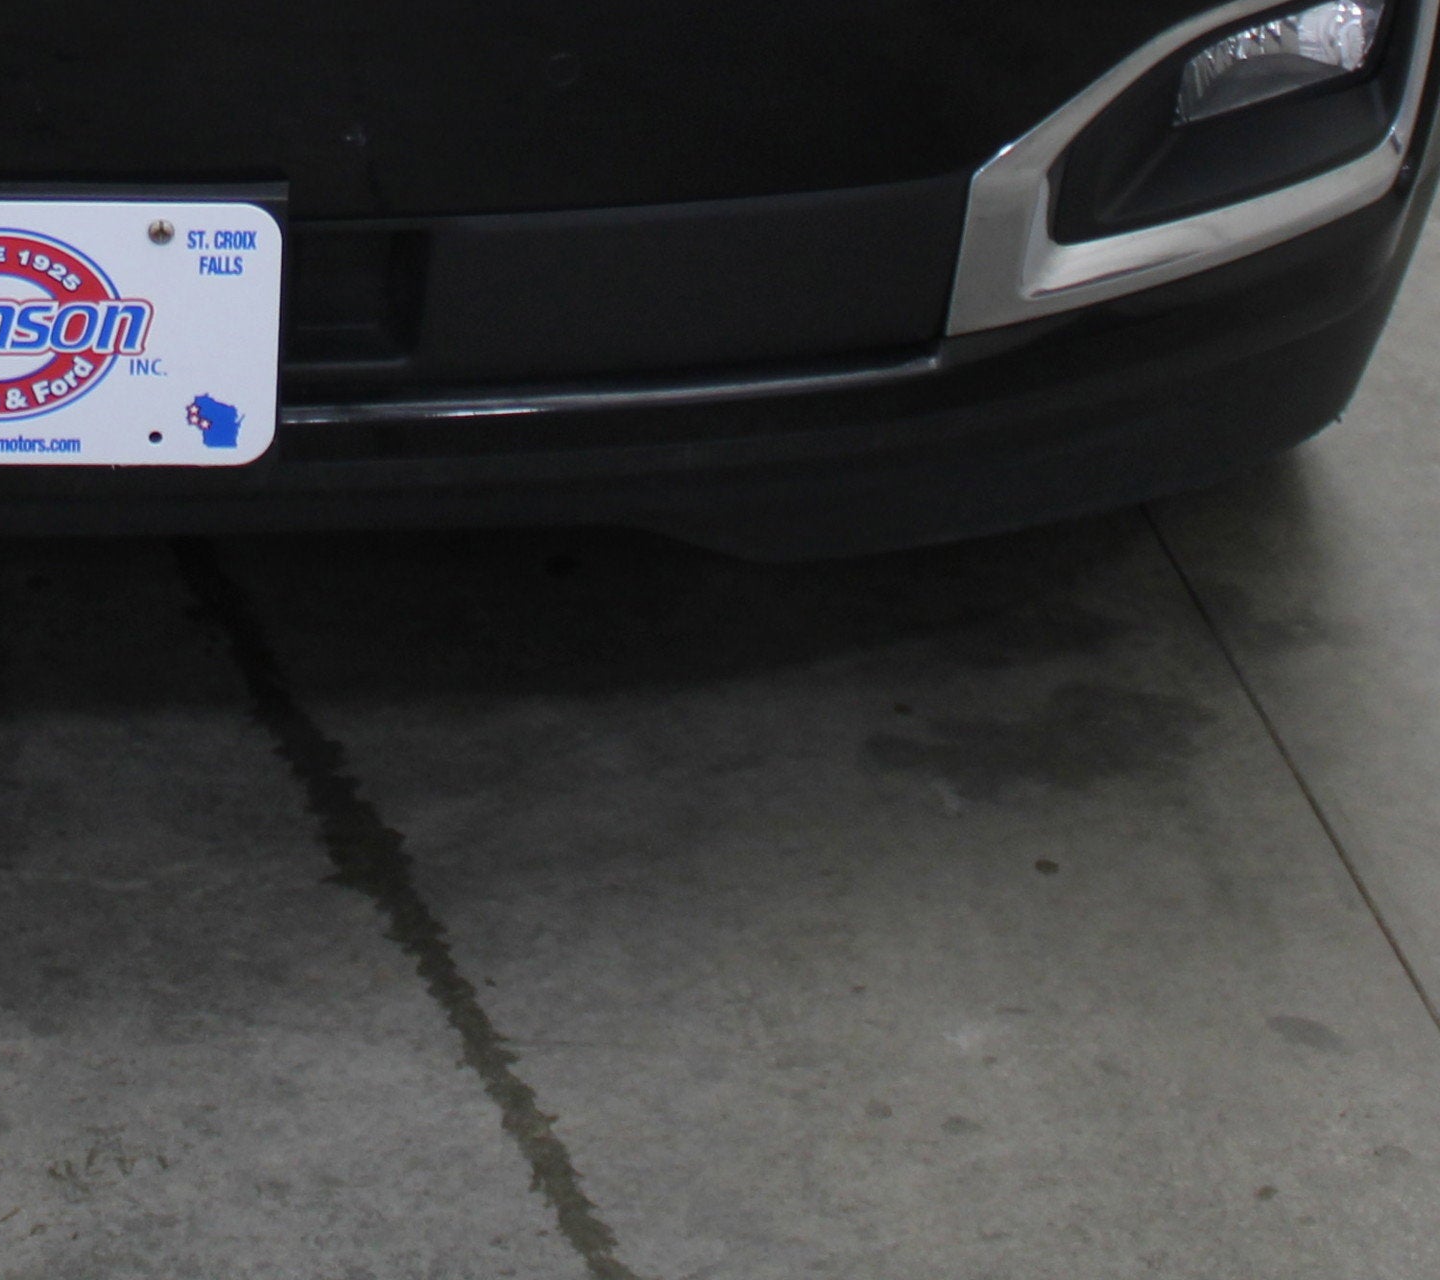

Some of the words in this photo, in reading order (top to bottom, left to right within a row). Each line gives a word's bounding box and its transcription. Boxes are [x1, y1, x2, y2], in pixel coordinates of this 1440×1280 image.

[187, 230, 209, 250] ST.
[213, 230, 257, 250] CROIX
[18, 249, 82, 291] 1925
[199, 256, 243, 275] FALLS
[129, 358, 168, 376] INC.
[5, 388, 29, 410] &
[32, 356, 95, 405] Ford
